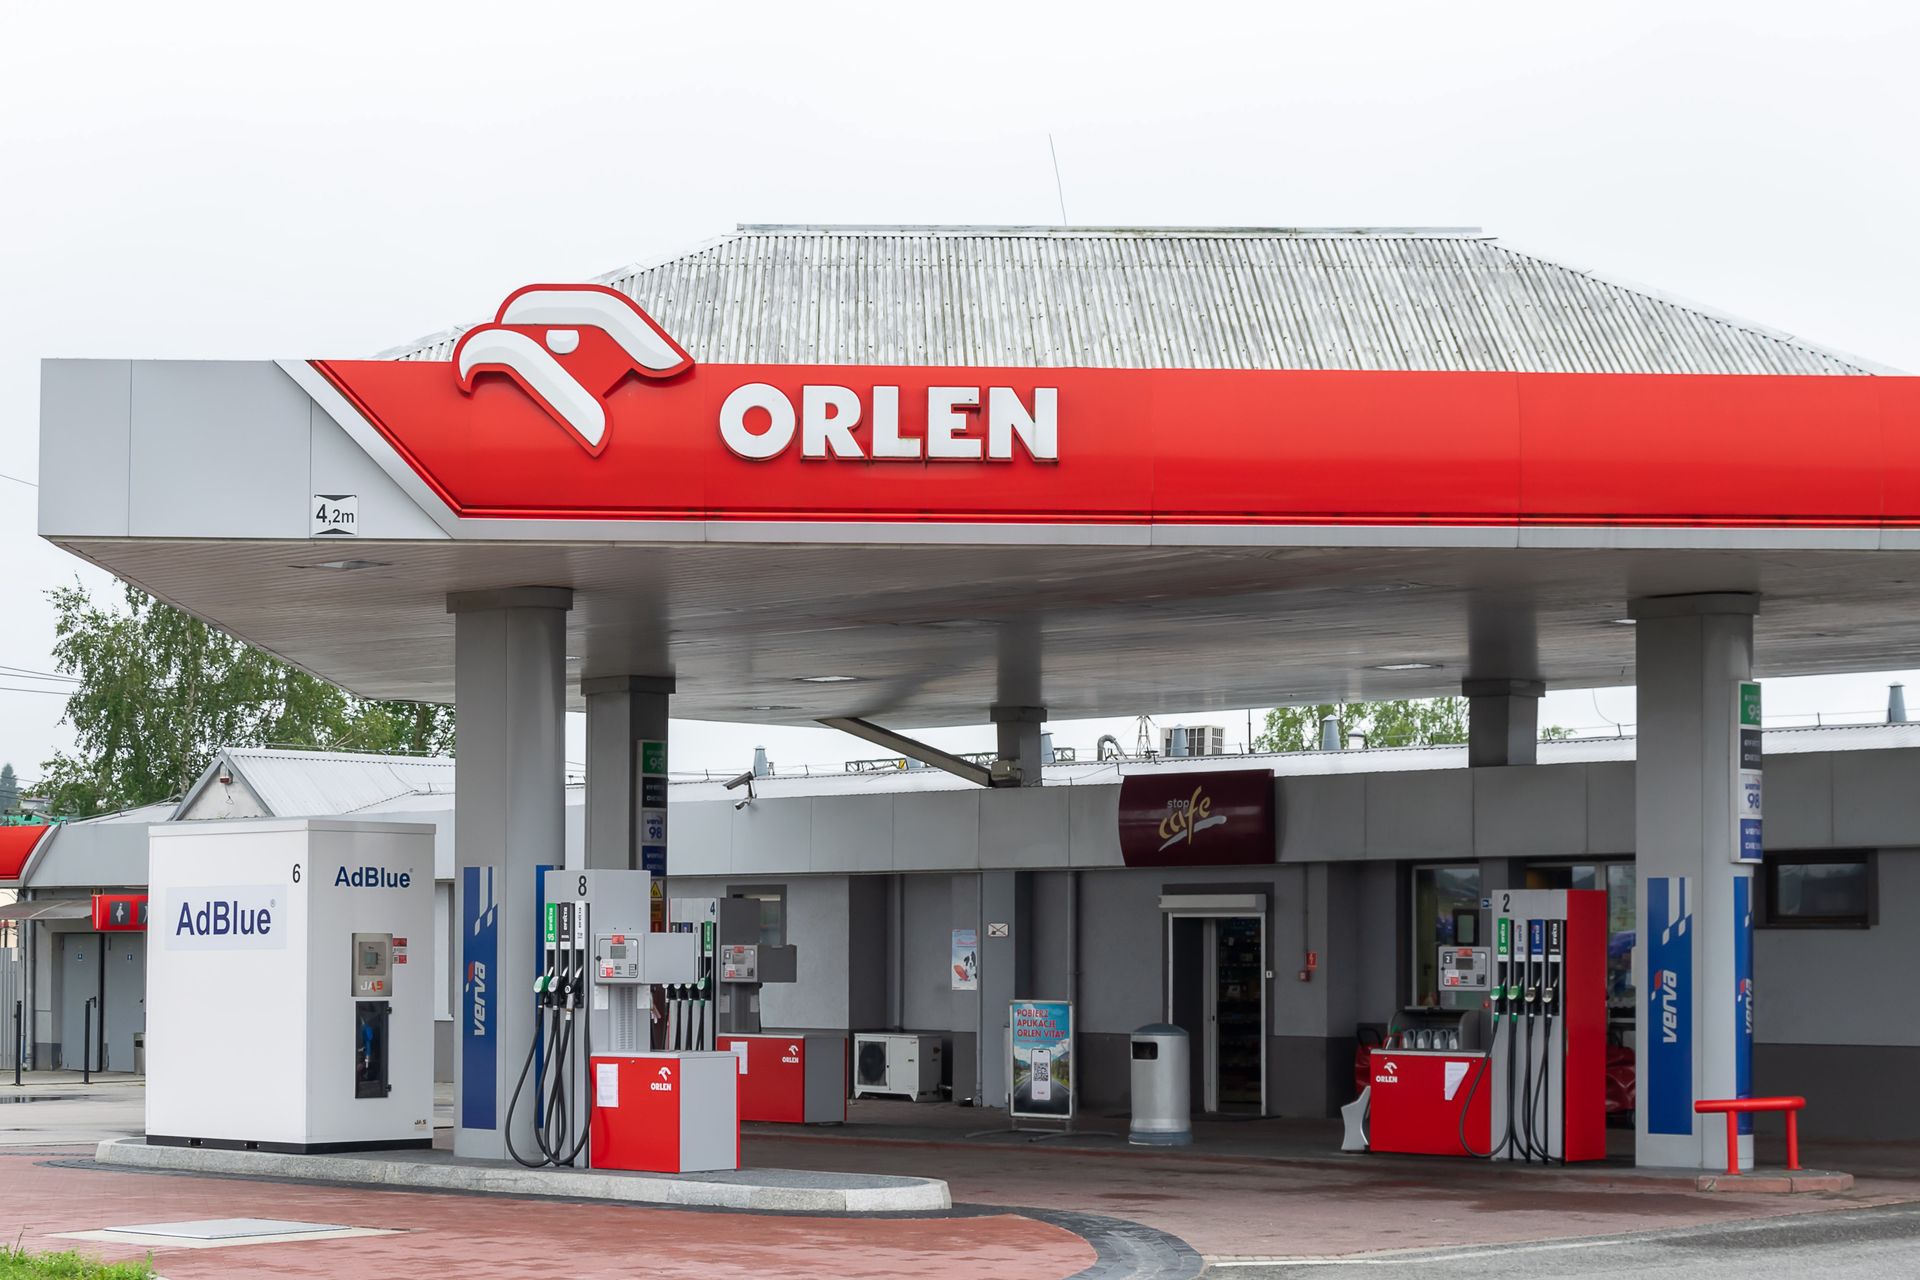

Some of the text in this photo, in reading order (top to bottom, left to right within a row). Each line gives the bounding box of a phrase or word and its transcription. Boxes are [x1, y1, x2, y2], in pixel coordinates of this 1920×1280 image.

[719, 382, 1060, 463] ORLEN
[315, 503, 355, 525] 4,2m
[1167, 798, 1190, 814] stop
[1747, 793, 1760, 809] 98
[1159, 785, 1211, 845] cafe
[649, 827, 662, 839] 98
[292, 863, 301, 883] 6
[334, 866, 411, 888] AdBlue
[578, 875, 587, 897] 8
[710, 901, 715, 916] 4
[1503, 893, 1510, 913] 2
[175, 900, 272, 936] AdBlue
[474, 961, 486, 1036] verva
[1663, 969, 1677, 1043] verva
[1016, 1008, 1049, 1018] POBIERZ
[1017, 1029, 1042, 1038] ORLEN
[650, 1082, 672, 1091] ORLEN
[1375, 1075, 1398, 1083] ORLEN
